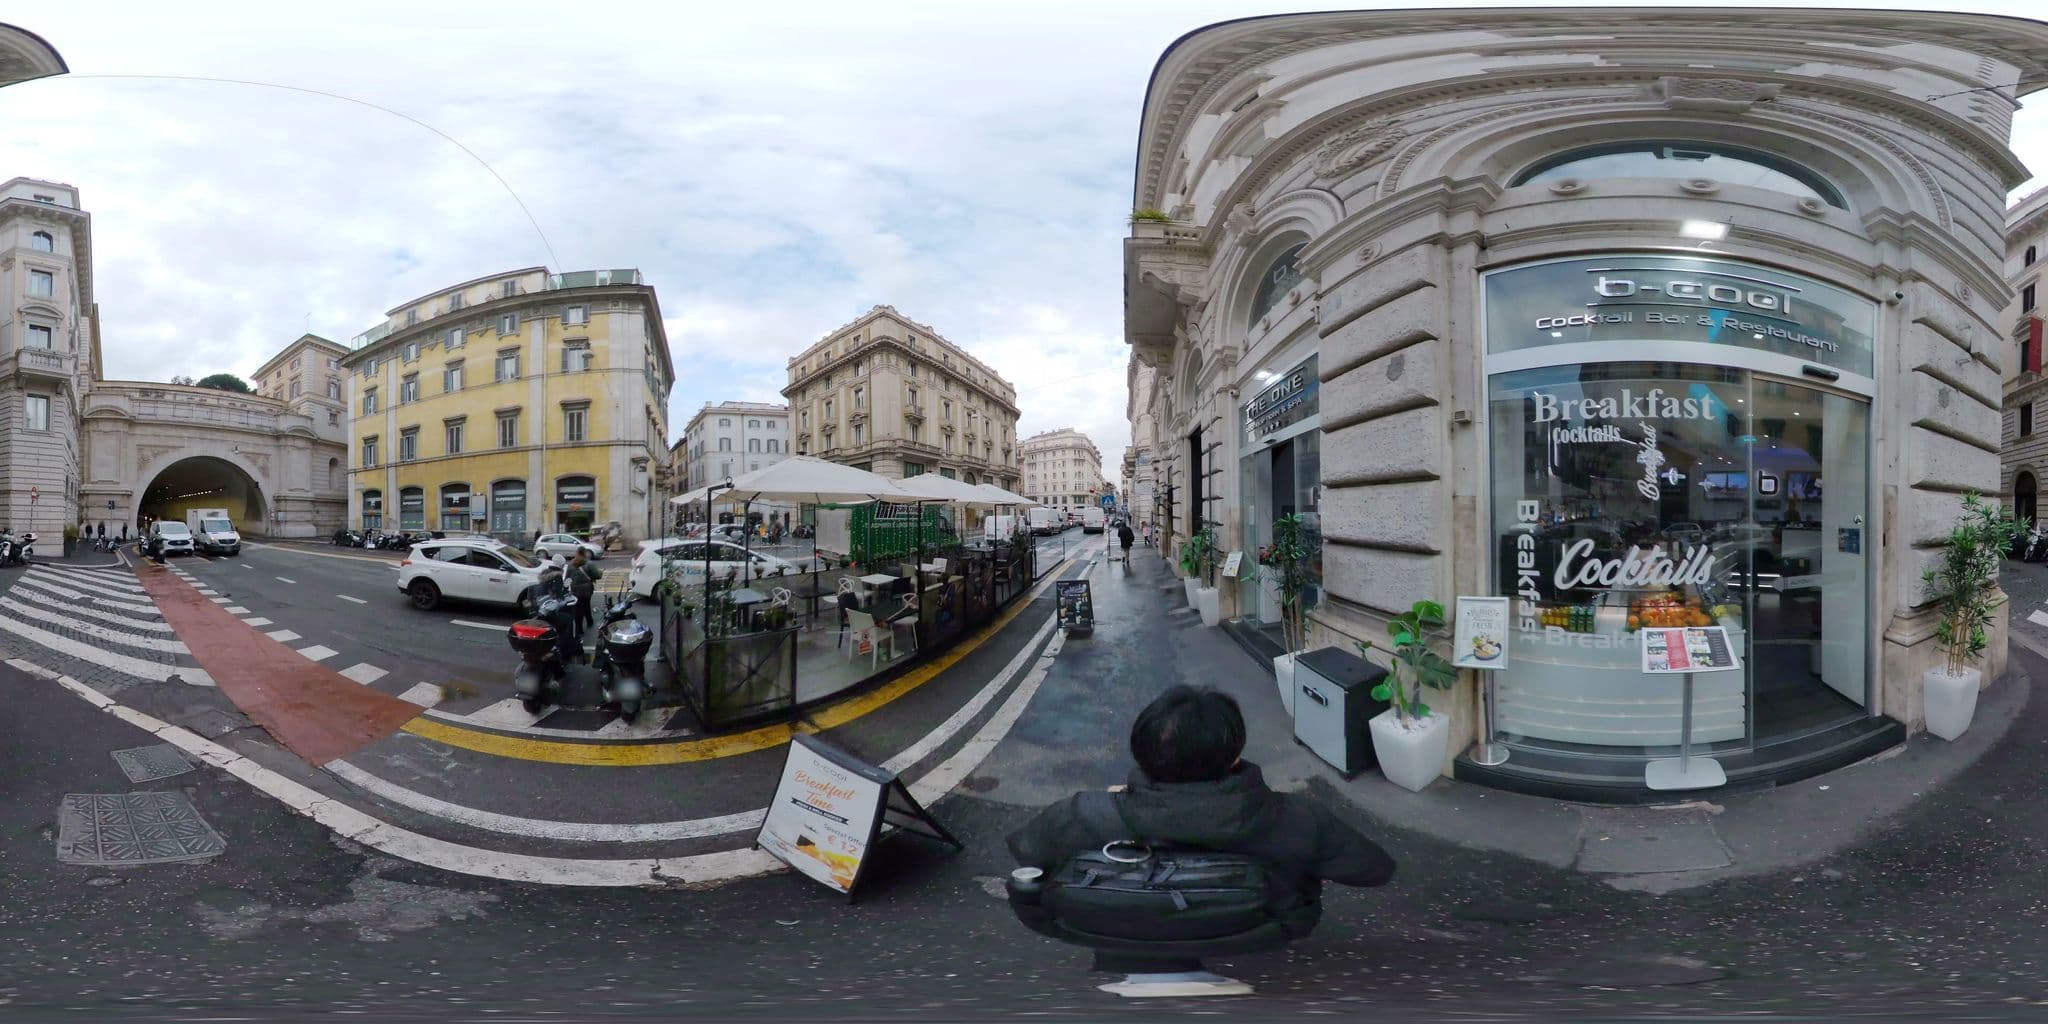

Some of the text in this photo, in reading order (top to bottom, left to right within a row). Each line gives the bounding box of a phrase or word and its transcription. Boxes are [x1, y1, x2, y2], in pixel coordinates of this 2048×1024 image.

[1594, 277, 1790, 314] b-cool
[1536, 311, 1839, 352] Cocktail Bar & Restaurant
[1246, 374, 1303, 421] THE ONE
[1533, 388, 1716, 423] Breakfast
[1553, 425, 1621, 445] Cocktails
[1637, 421, 1661, 501] Breakfast
[1554, 538, 1716, 591] Cocktails
[794, 770, 855, 800] Breakfast
[806, 790, 833, 811] Time
[841, 840, 857, 855] 12
